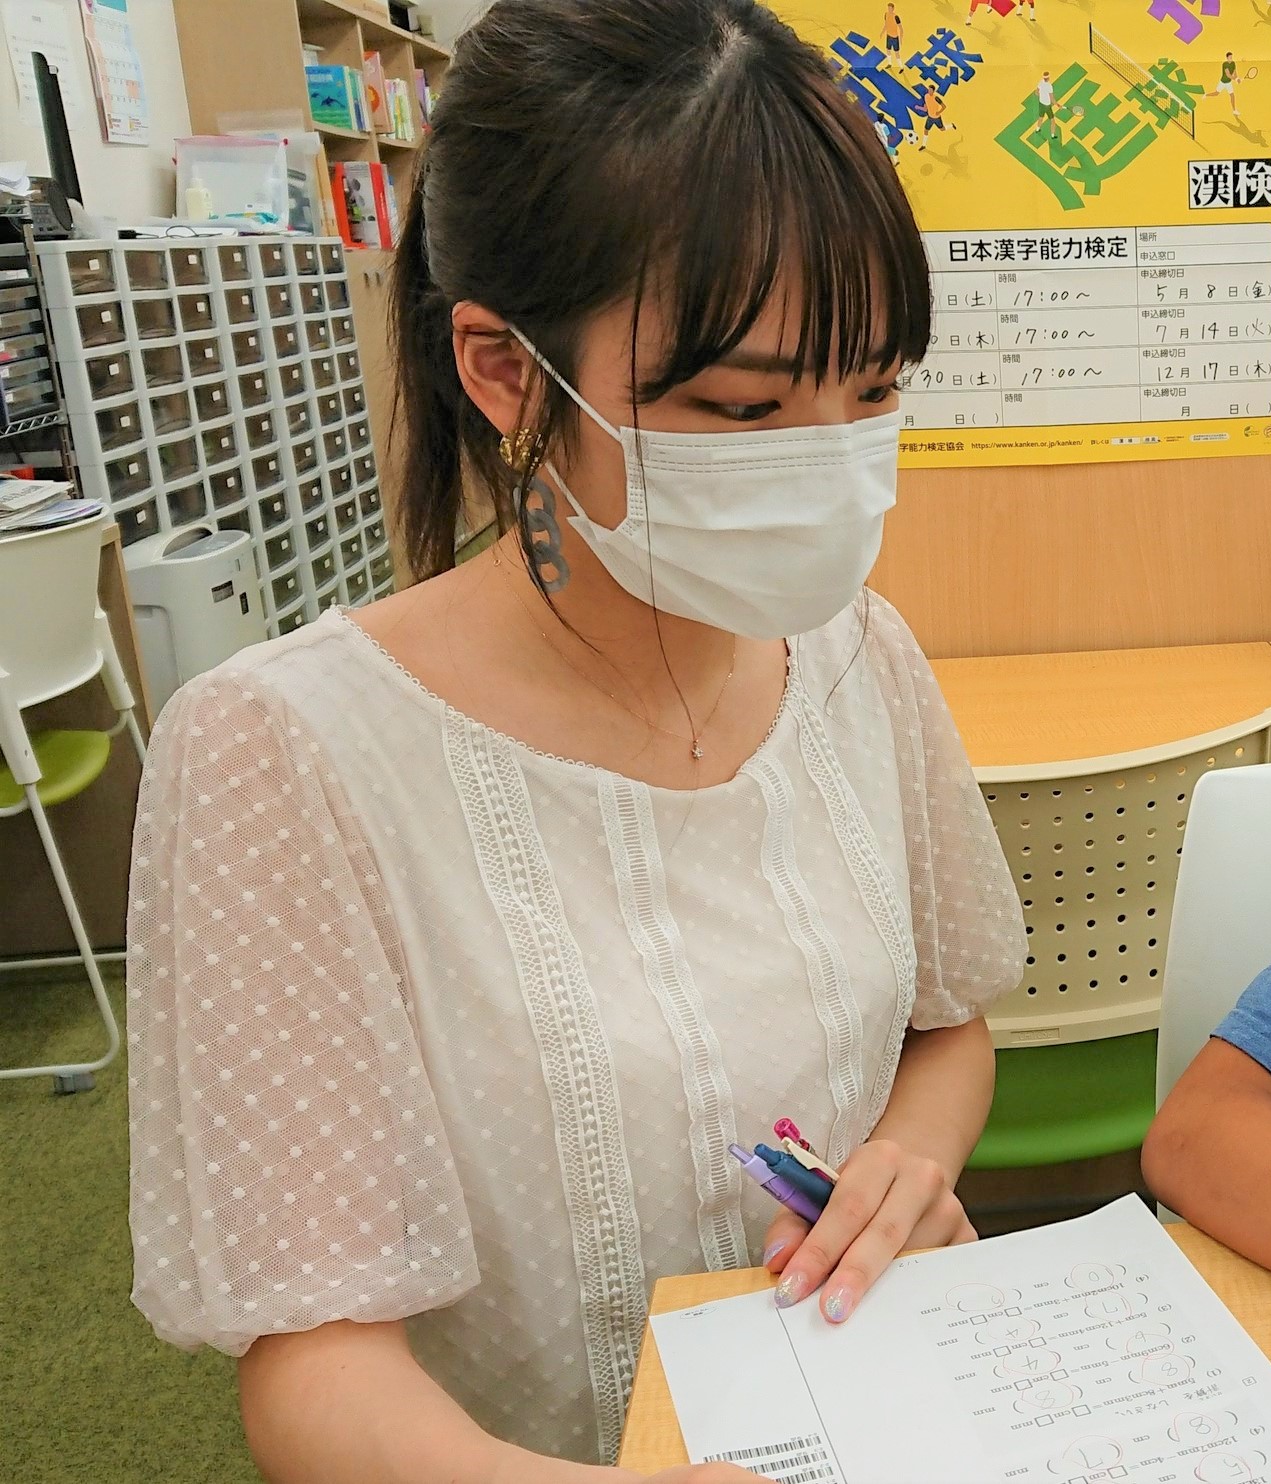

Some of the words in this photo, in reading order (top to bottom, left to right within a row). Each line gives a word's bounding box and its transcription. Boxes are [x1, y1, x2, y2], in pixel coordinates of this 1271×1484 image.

[1139, 232, 1157, 242] 場所
[949, 236, 1128, 262] 日本漢字能力検定
[1140, 251, 1175, 261] 申込窓口
[999, 274, 1016, 283] 時間
[1141, 268, 1184, 279] 申込締切日
[1001, 314, 1018, 323] 時間
[1141, 309, 1185, 318] 申込締切日
[1142, 348, 1186, 358] 申込締切日
[1003, 355, 1020, 363] 時間
[1144, 388, 1187, 397] 申込締切日
[1005, 394, 1023, 402] 時間
[971, 439, 1083, 449] https://www.kanken.or.jp/kanken/
[1135, 1274, 1149, 1283] (4)
[1033, 1281, 1049, 1290] cm
[920, 1306, 942, 1316] mm
[1157, 1303, 1172, 1313] (3)
[1053, 1312, 1069, 1321] cm
[937, 1338, 958, 1348] mm
[1181, 1334, 1196, 1344] (2)
[1073, 1343, 1090, 1351] cm
[954, 1372, 977, 1382] mm
[1206, 1368, 1221, 1377] (1)
[1095, 1377, 1112, 1385] cm
[973, 1406, 996, 1417] mm
[1114, 1399, 1169, 1415] しなさい。
[1249, 1425, 1266, 1436] (4)
[1132, 1434, 1151, 1445] cm
[1004, 1466, 1029, 1478] mm
